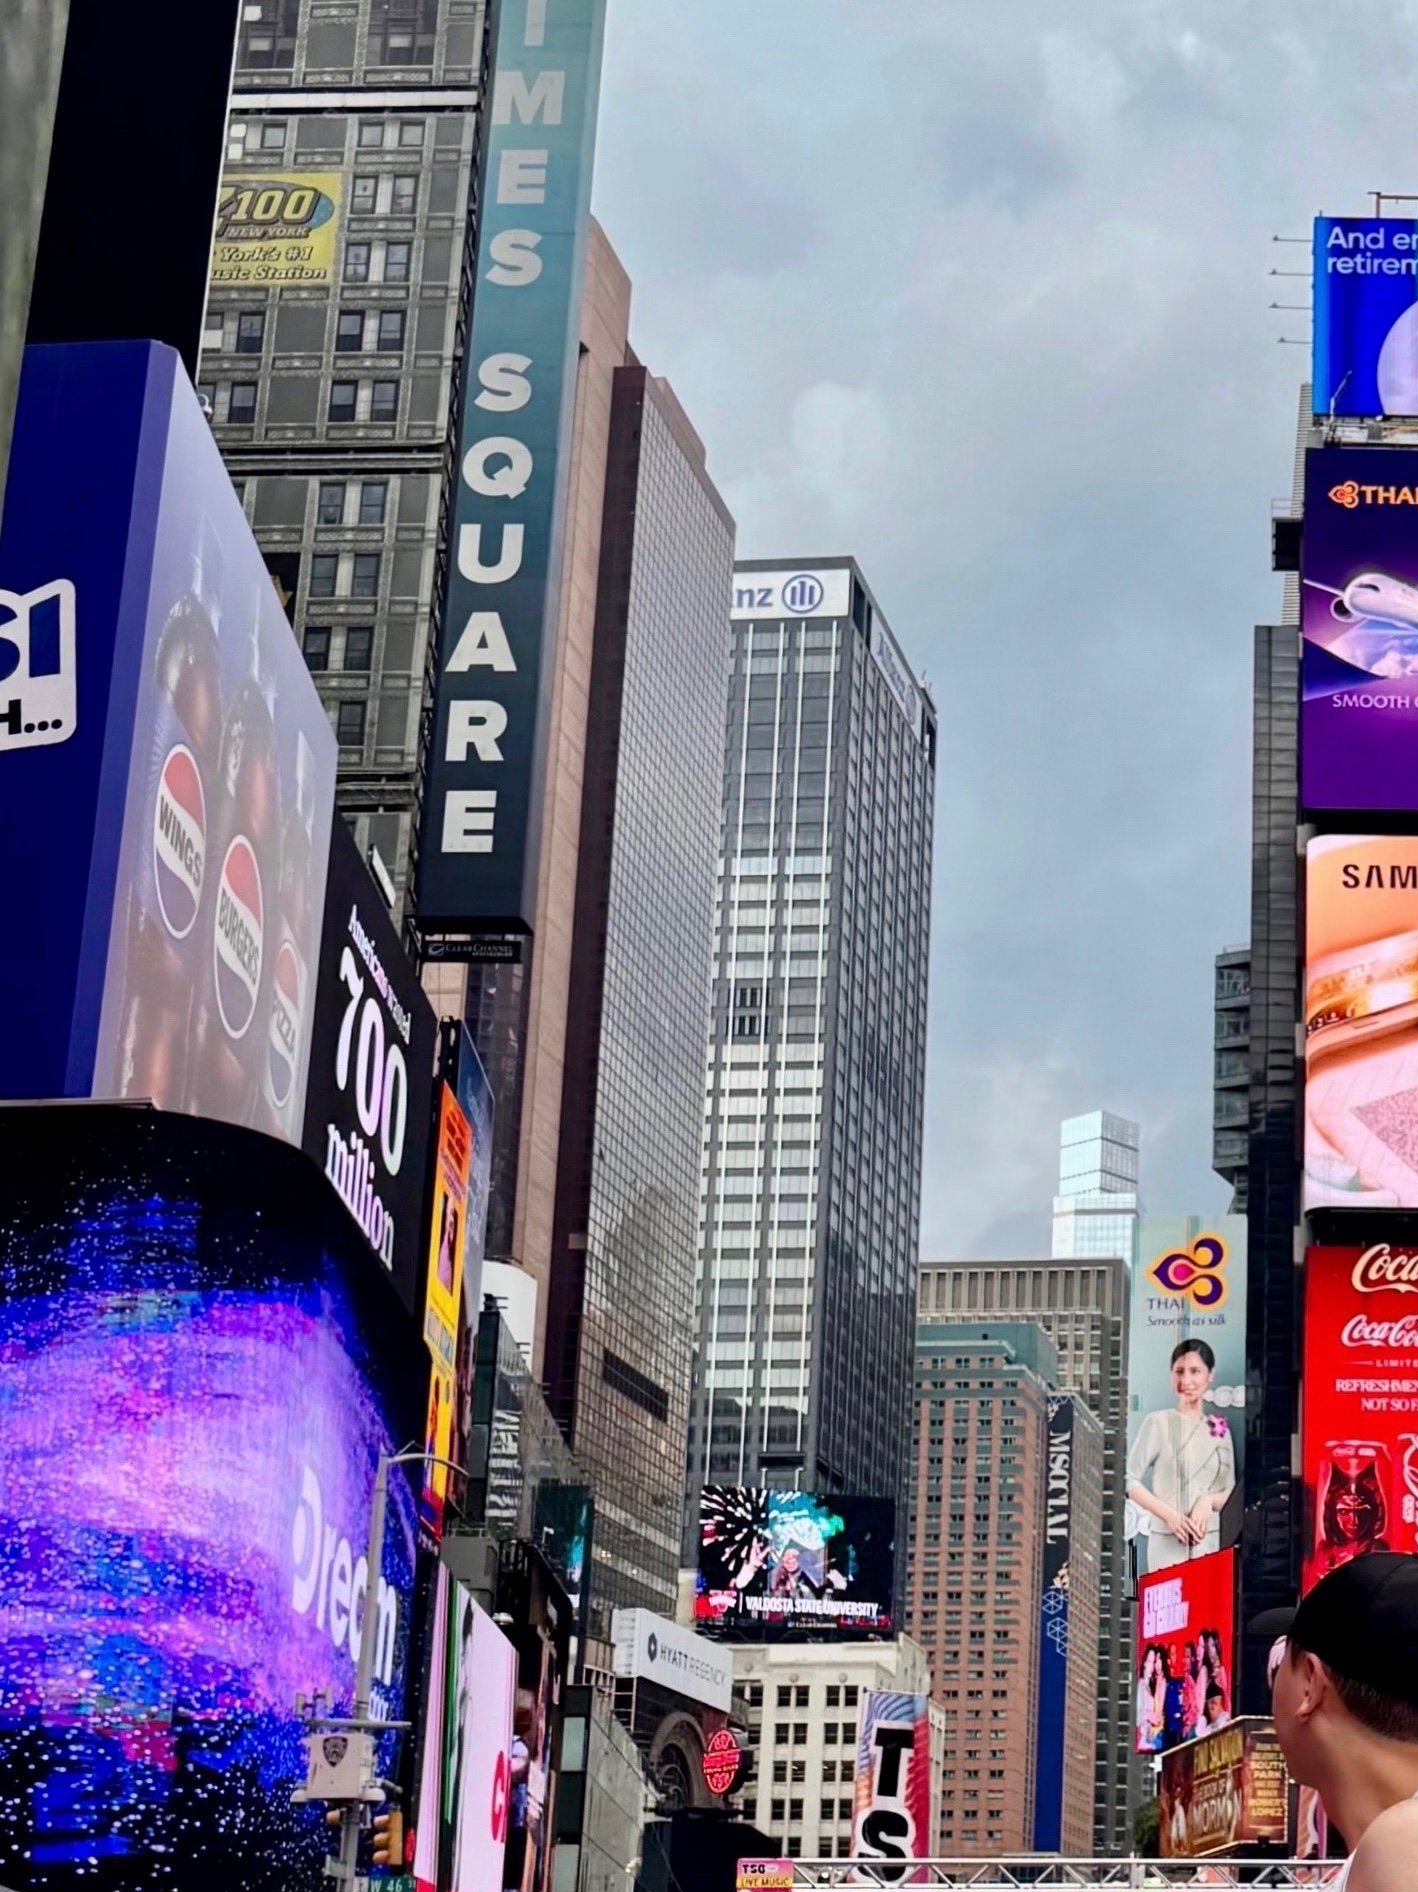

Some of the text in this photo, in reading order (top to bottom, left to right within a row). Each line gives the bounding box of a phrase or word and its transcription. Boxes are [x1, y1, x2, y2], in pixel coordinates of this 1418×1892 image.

[229, 226, 311, 238] NEW YORK
[1327, 226, 1384, 249] And
[221, 246, 313, 261] York's #1
[254, 265, 327, 279] Station
[440, 354, 534, 854] SQUARE
[1332, 694, 1410, 710] SMOOTH
[159, 795, 201, 888] WINGS
[217, 884, 260, 986] BURGERS
[336, 946, 407, 1176] 700
[326, 1123, 394, 1272] million
[1147, 1297, 1186, 1310] THAI
[1361, 1398, 1389, 1411] NOT
[1391, 1398, 1409, 1412] SO
[745, 1596, 879, 1618] VALDOSTA STATE UNIVERSITY
[661, 1643, 727, 1687] HYATT REGENCY
[742, 1864, 766, 1874] TSQ
